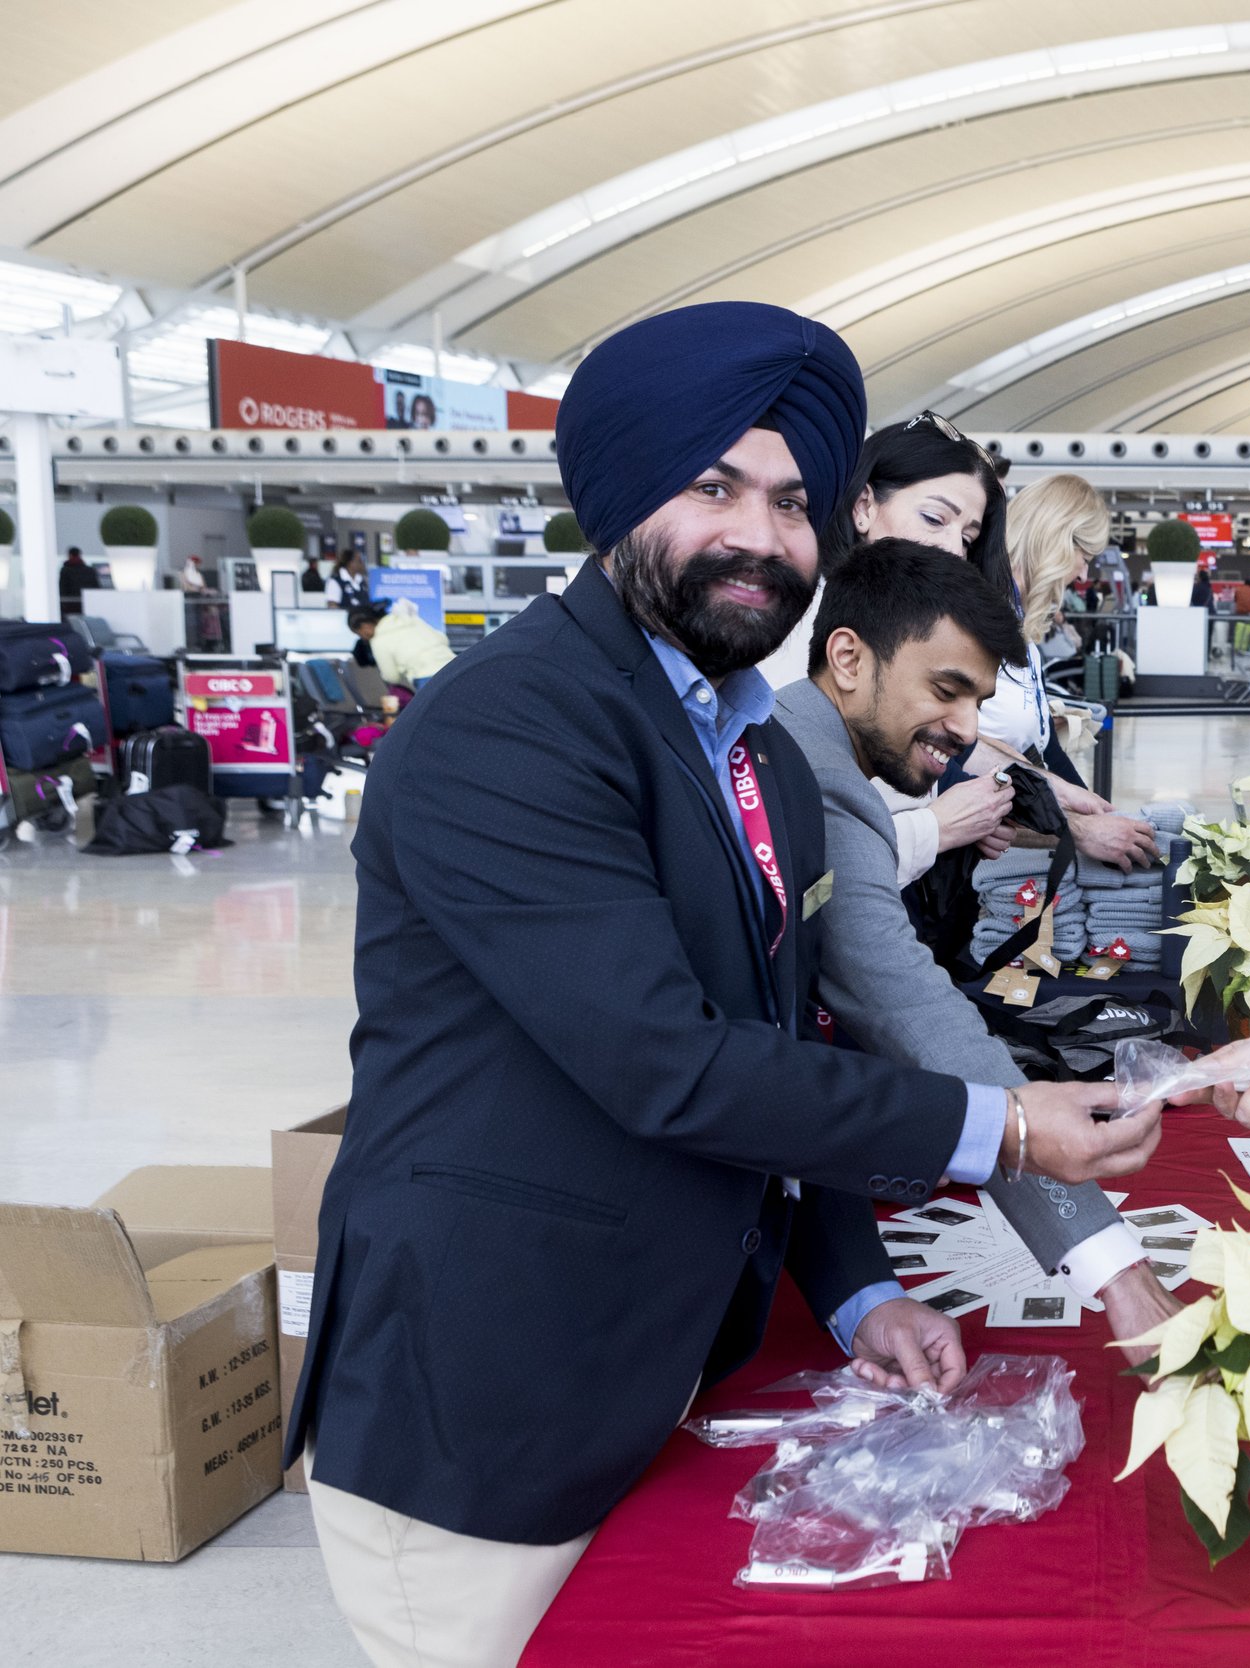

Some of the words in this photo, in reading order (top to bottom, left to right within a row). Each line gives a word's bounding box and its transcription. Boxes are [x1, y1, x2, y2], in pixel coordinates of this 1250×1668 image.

[261, 402, 327, 430] ROGERS
[207, 678, 240, 692] CIBC
[733, 763, 759, 811] CIBC
[763, 863, 787, 907] CIBC
[28, 1390, 60, 1416] let
[47, 1445, 68, 1457] NA
[67, 1460, 98, 1472] PCS.
[5, 1469, 23, 1480] No
[57, 1473, 75, 1483] OF
[78, 1475, 102, 1485] 560
[0, 1482, 14, 1493] DE
[18, 1484, 31, 1493] IN
[35, 1484, 75, 1496] INDIA.
